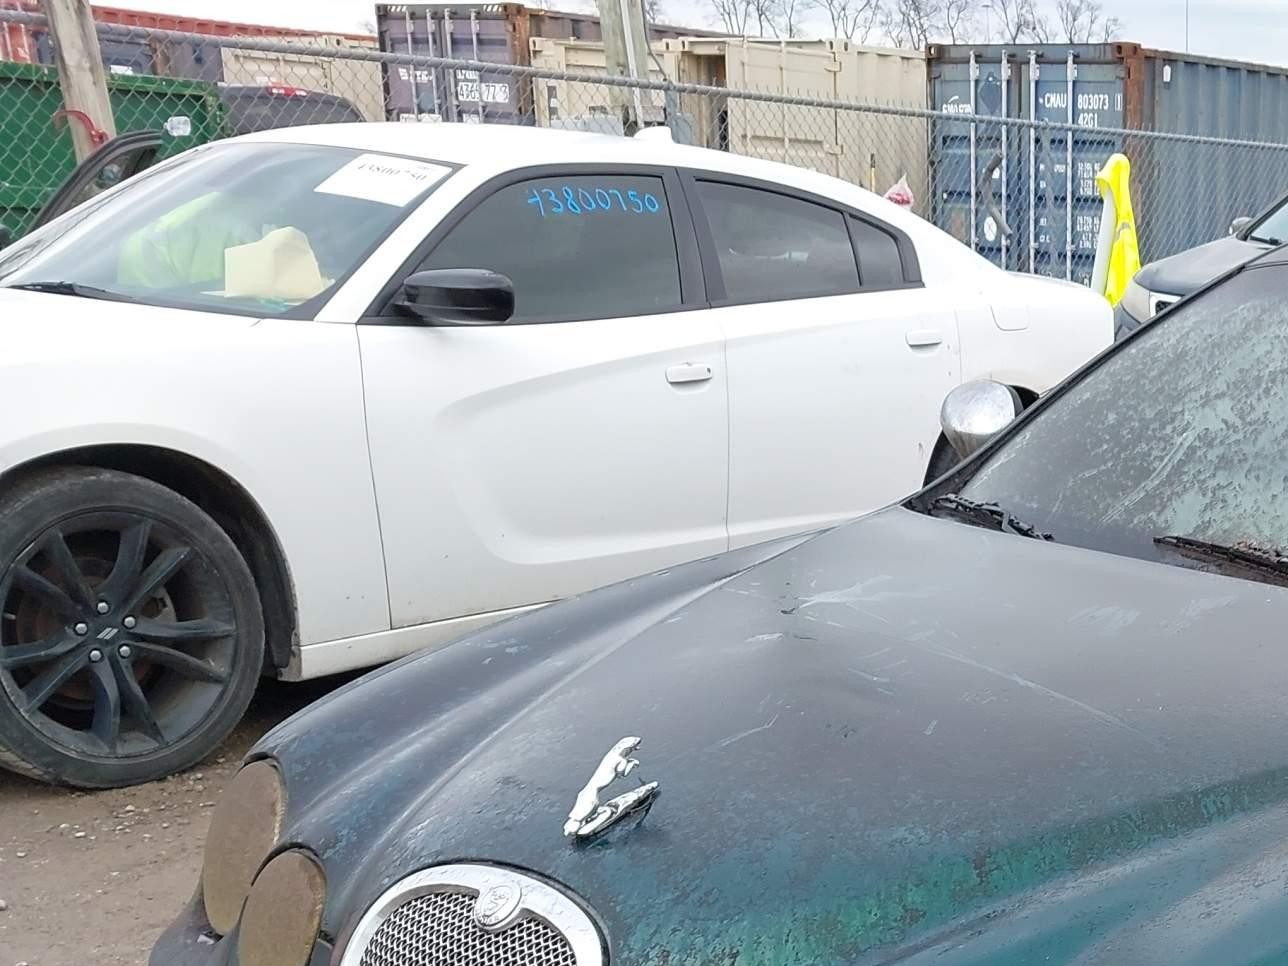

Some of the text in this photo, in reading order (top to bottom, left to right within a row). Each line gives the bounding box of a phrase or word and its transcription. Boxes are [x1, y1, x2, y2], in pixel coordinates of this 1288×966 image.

[1044, 93, 1067, 108] CMAU
[1077, 94, 1109, 110] 803073
[527, 186, 659, 217] 43800750
